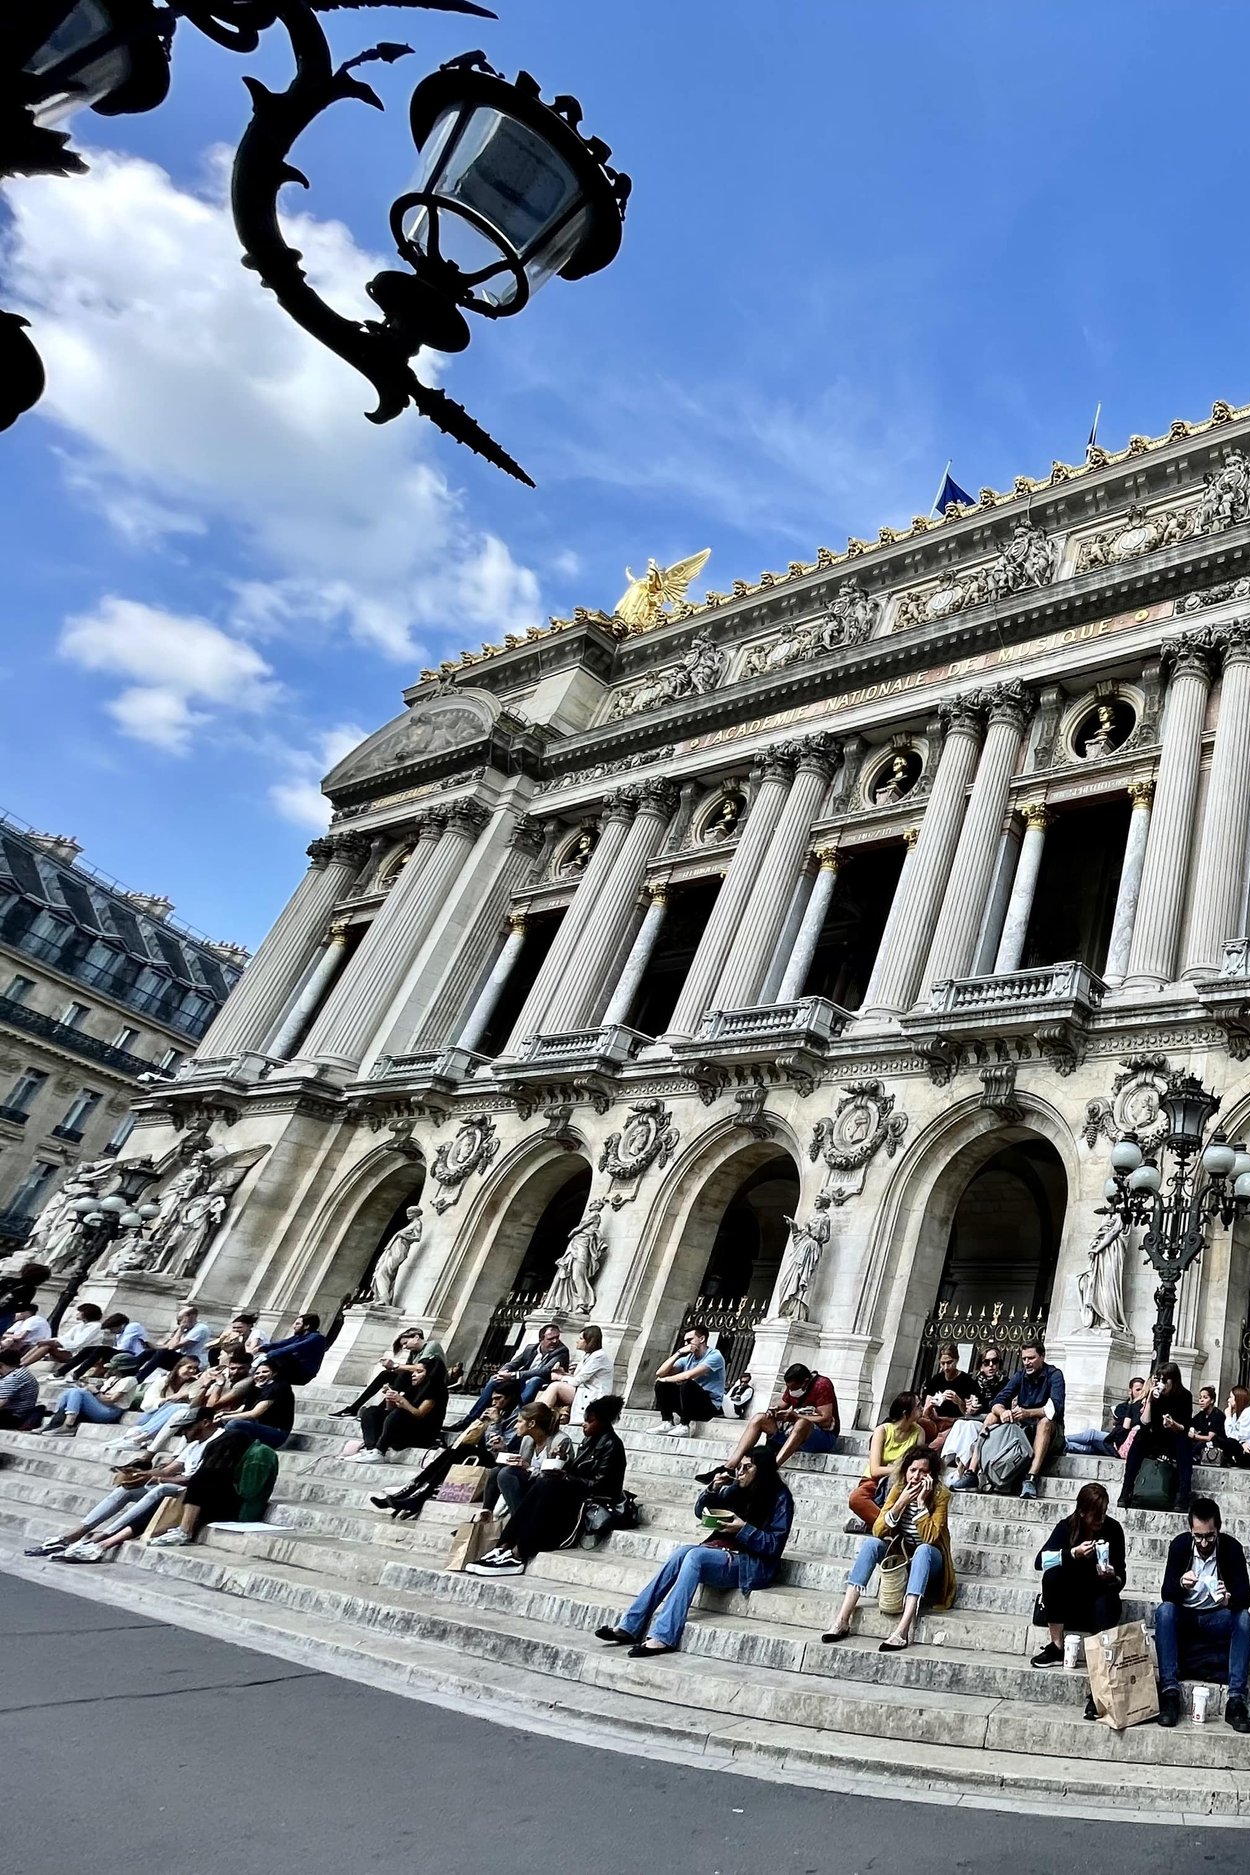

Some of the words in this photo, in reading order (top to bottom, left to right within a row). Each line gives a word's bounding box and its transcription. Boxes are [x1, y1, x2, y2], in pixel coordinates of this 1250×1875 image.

[712, 705, 809, 743] ACADEMIE
[823, 671, 928, 712] NATIONALE
[947, 657, 980, 677] DE
[997, 618, 1113, 663] MUSIQUE
